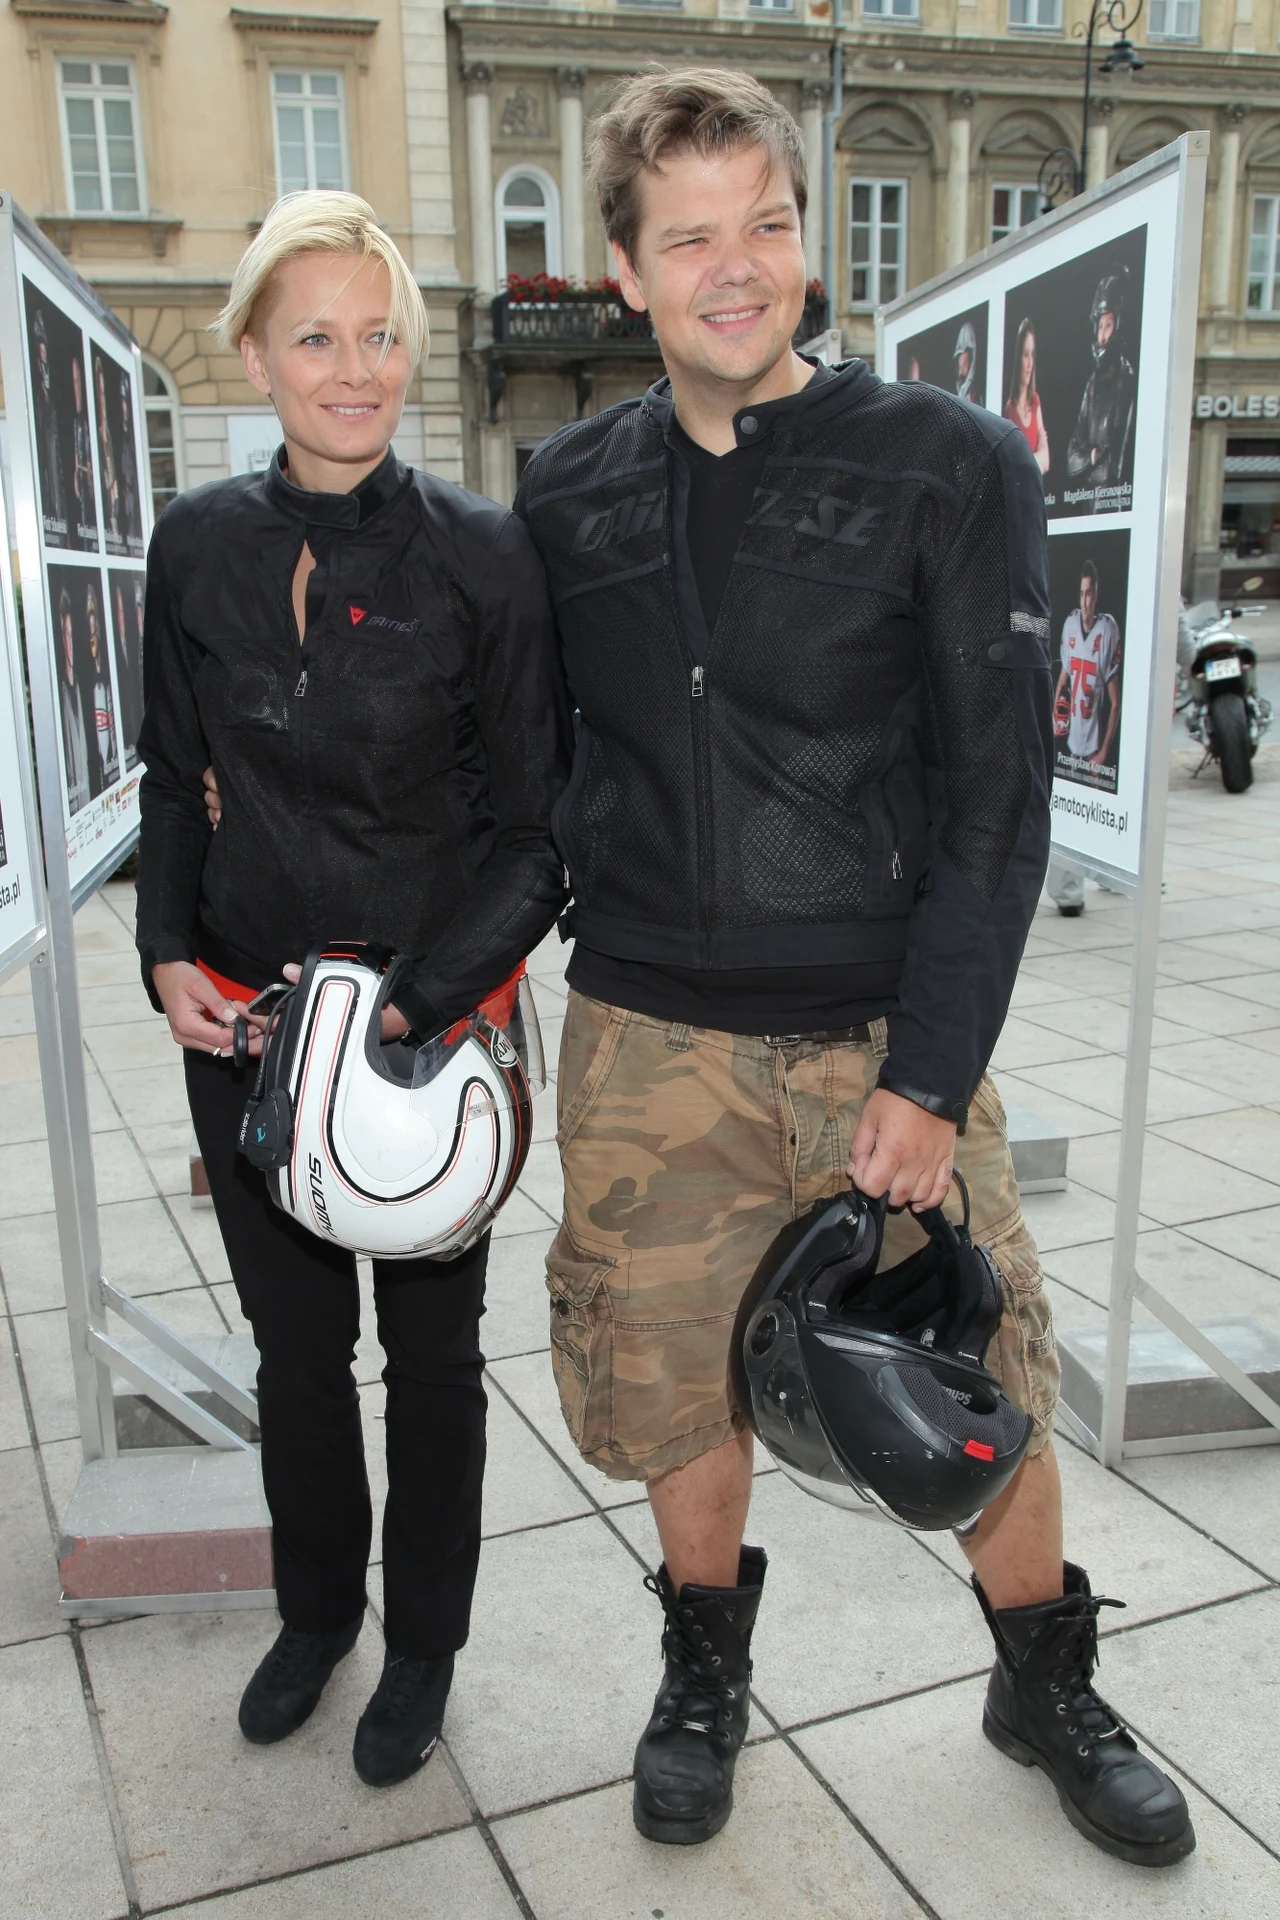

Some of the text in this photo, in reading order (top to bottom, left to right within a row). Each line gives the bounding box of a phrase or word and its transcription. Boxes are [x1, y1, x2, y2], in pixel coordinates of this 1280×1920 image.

[1196, 395, 1279, 418] BOLES
[1063, 488, 1095, 504] Magdalena
[1070, 656, 1097, 719] 75
[308, 1152, 338, 1238] SUOMY
